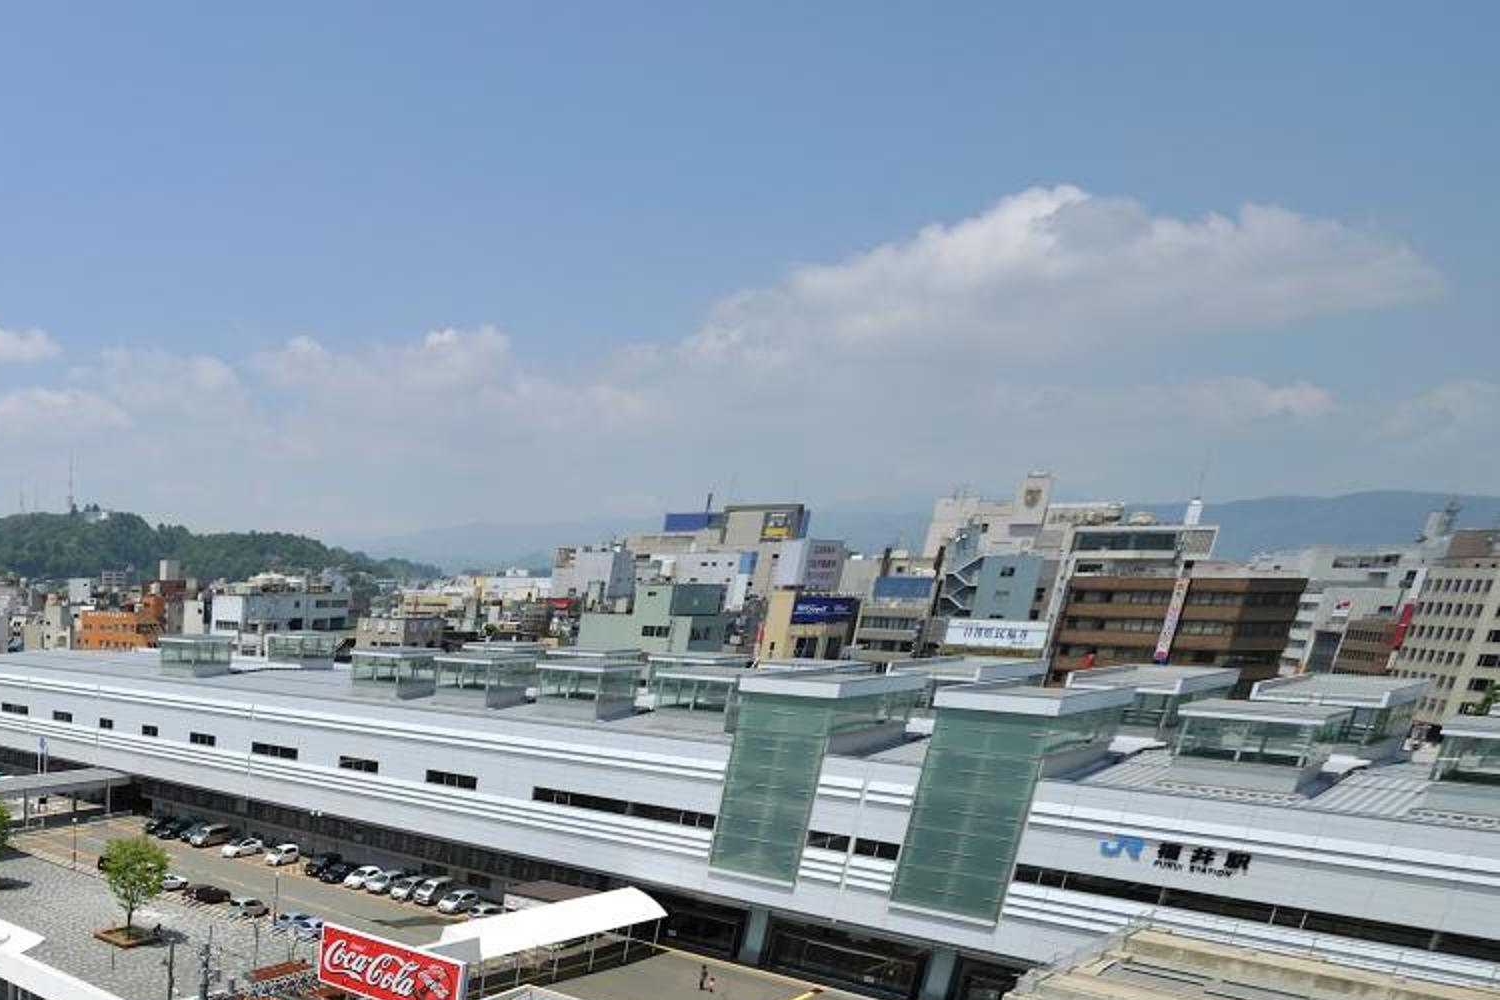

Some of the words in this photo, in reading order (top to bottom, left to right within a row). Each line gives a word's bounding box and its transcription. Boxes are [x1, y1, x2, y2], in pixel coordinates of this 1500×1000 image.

[1156, 842, 1252, 872] 福井駅
[1189, 864, 1234, 878] STATION
[324, 939, 420, 996] Coca-Cola
